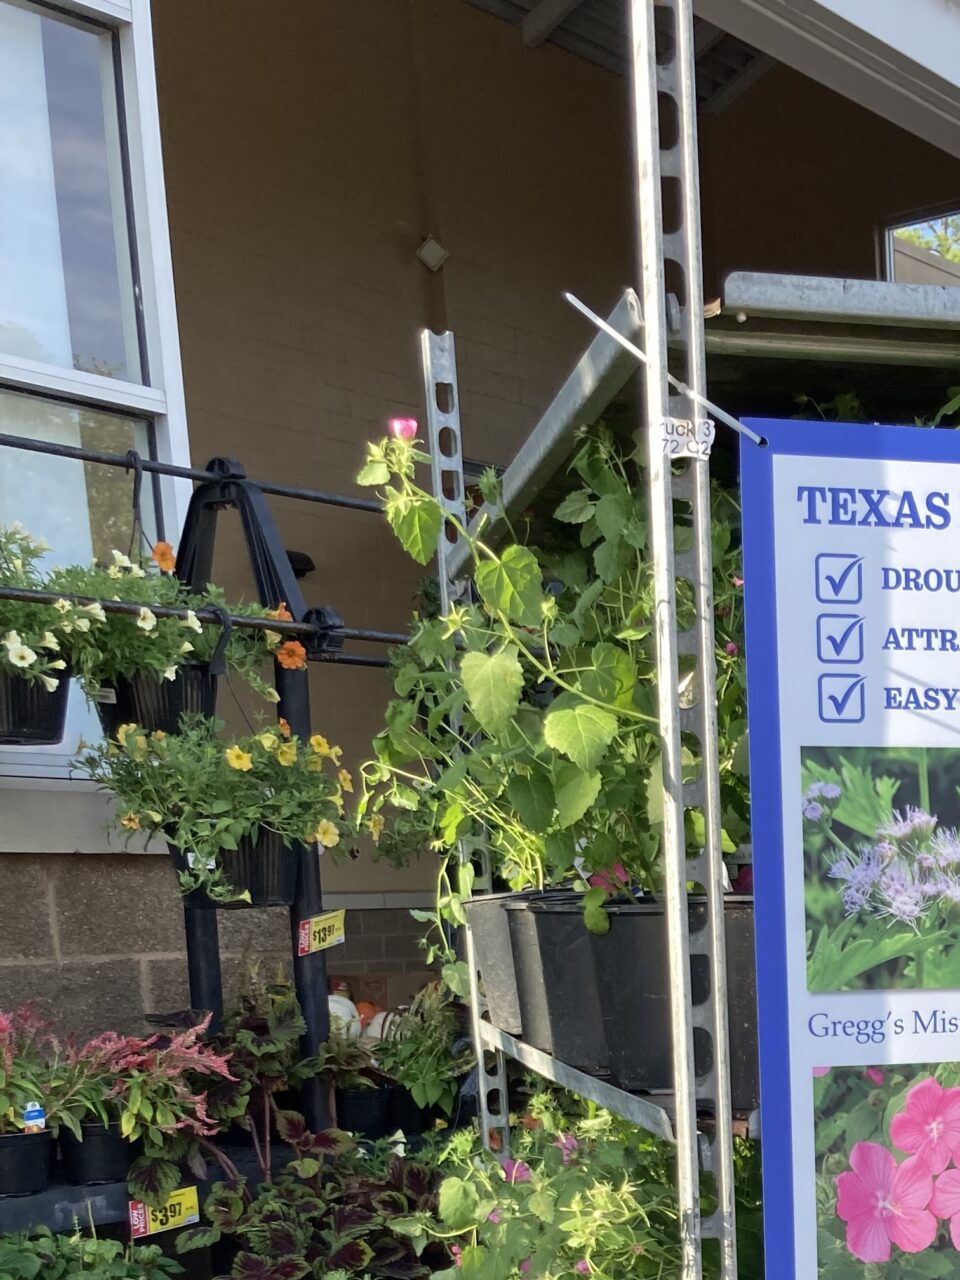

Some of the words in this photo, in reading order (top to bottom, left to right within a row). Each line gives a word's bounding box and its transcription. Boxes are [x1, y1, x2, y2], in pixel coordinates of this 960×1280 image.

[797, 486, 950, 530] TEXAS
[884, 687, 960, 711] EASY
[808, 1011, 904, 1044] Gregg's
[131, 1210, 139, 1229] LOW
